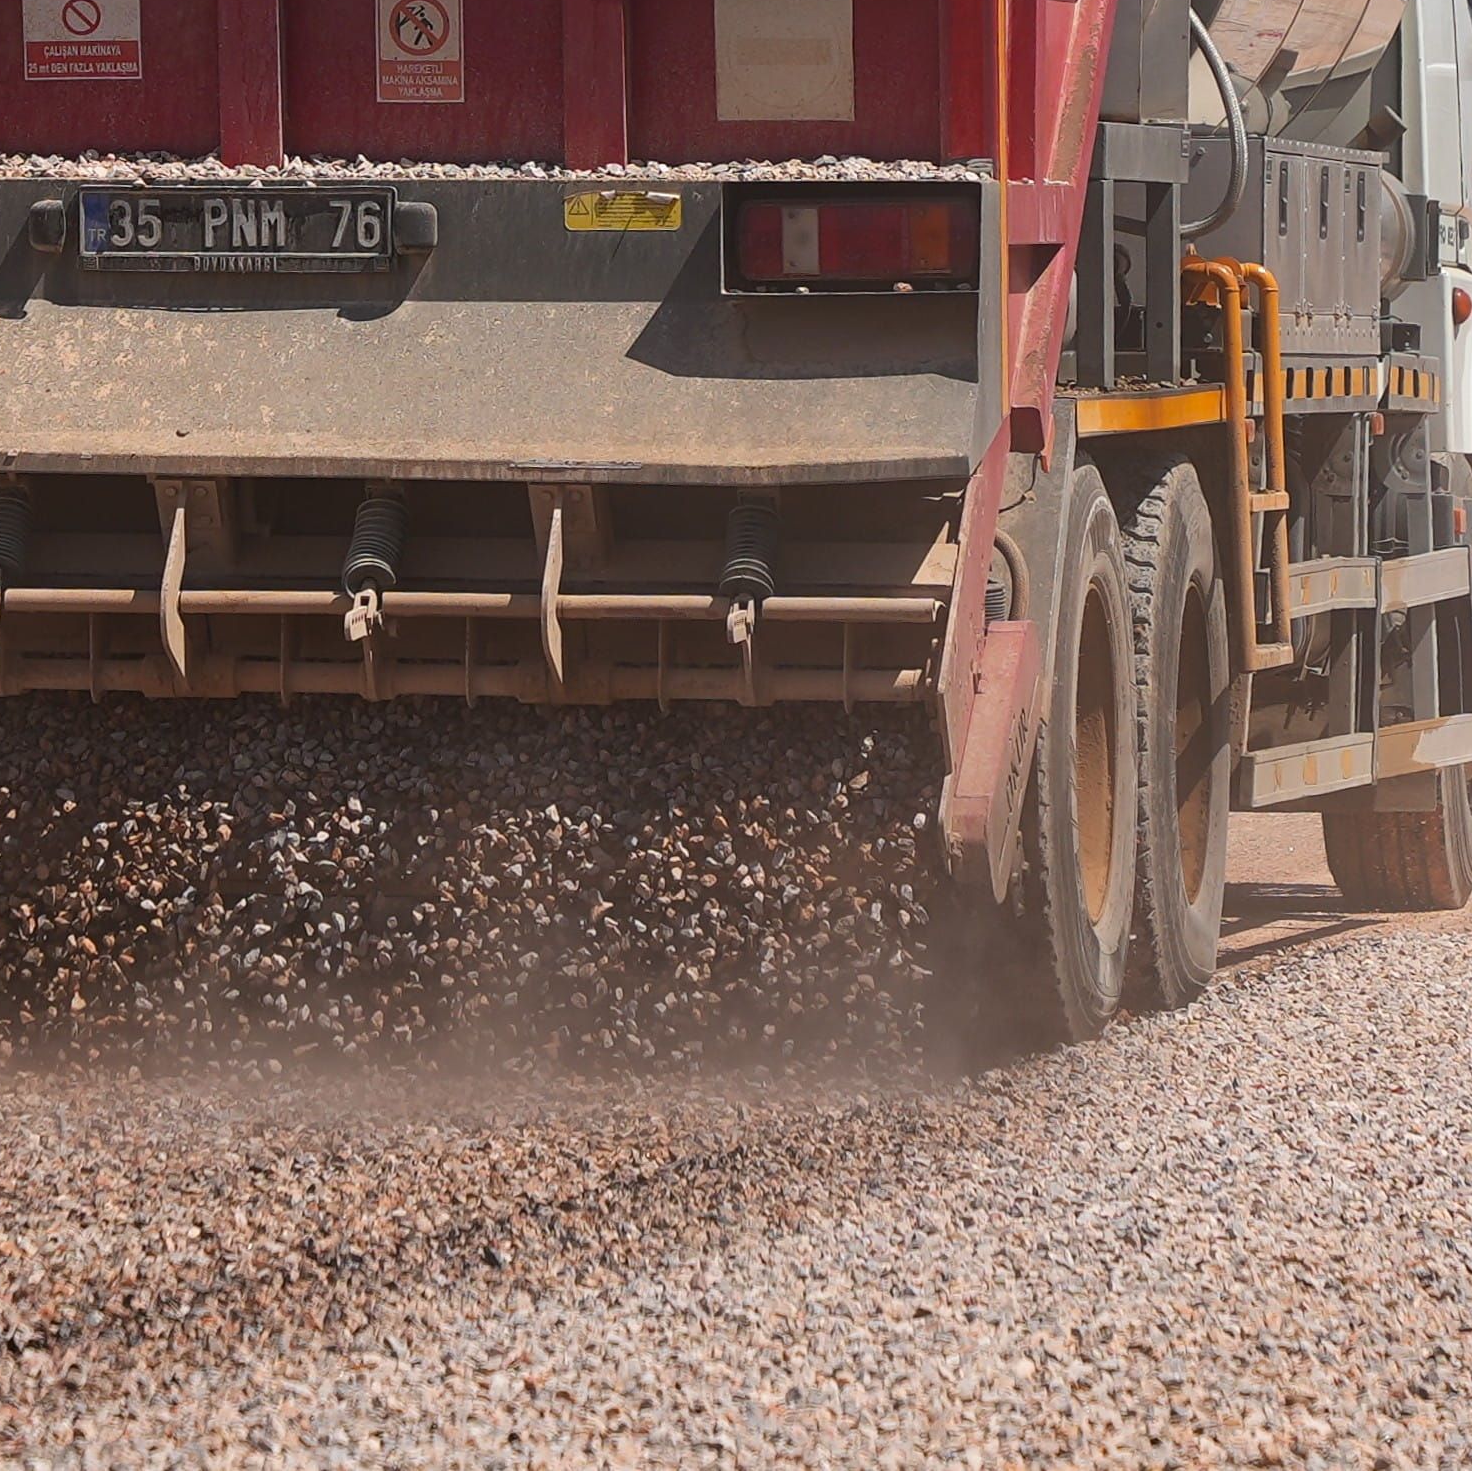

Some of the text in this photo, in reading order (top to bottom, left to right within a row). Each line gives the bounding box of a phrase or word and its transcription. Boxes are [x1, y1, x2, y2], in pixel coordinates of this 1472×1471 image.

[43, 45, 79, 59] ÇALIŞAN
[87, 198, 381, 248] TR 35 PNM 76
